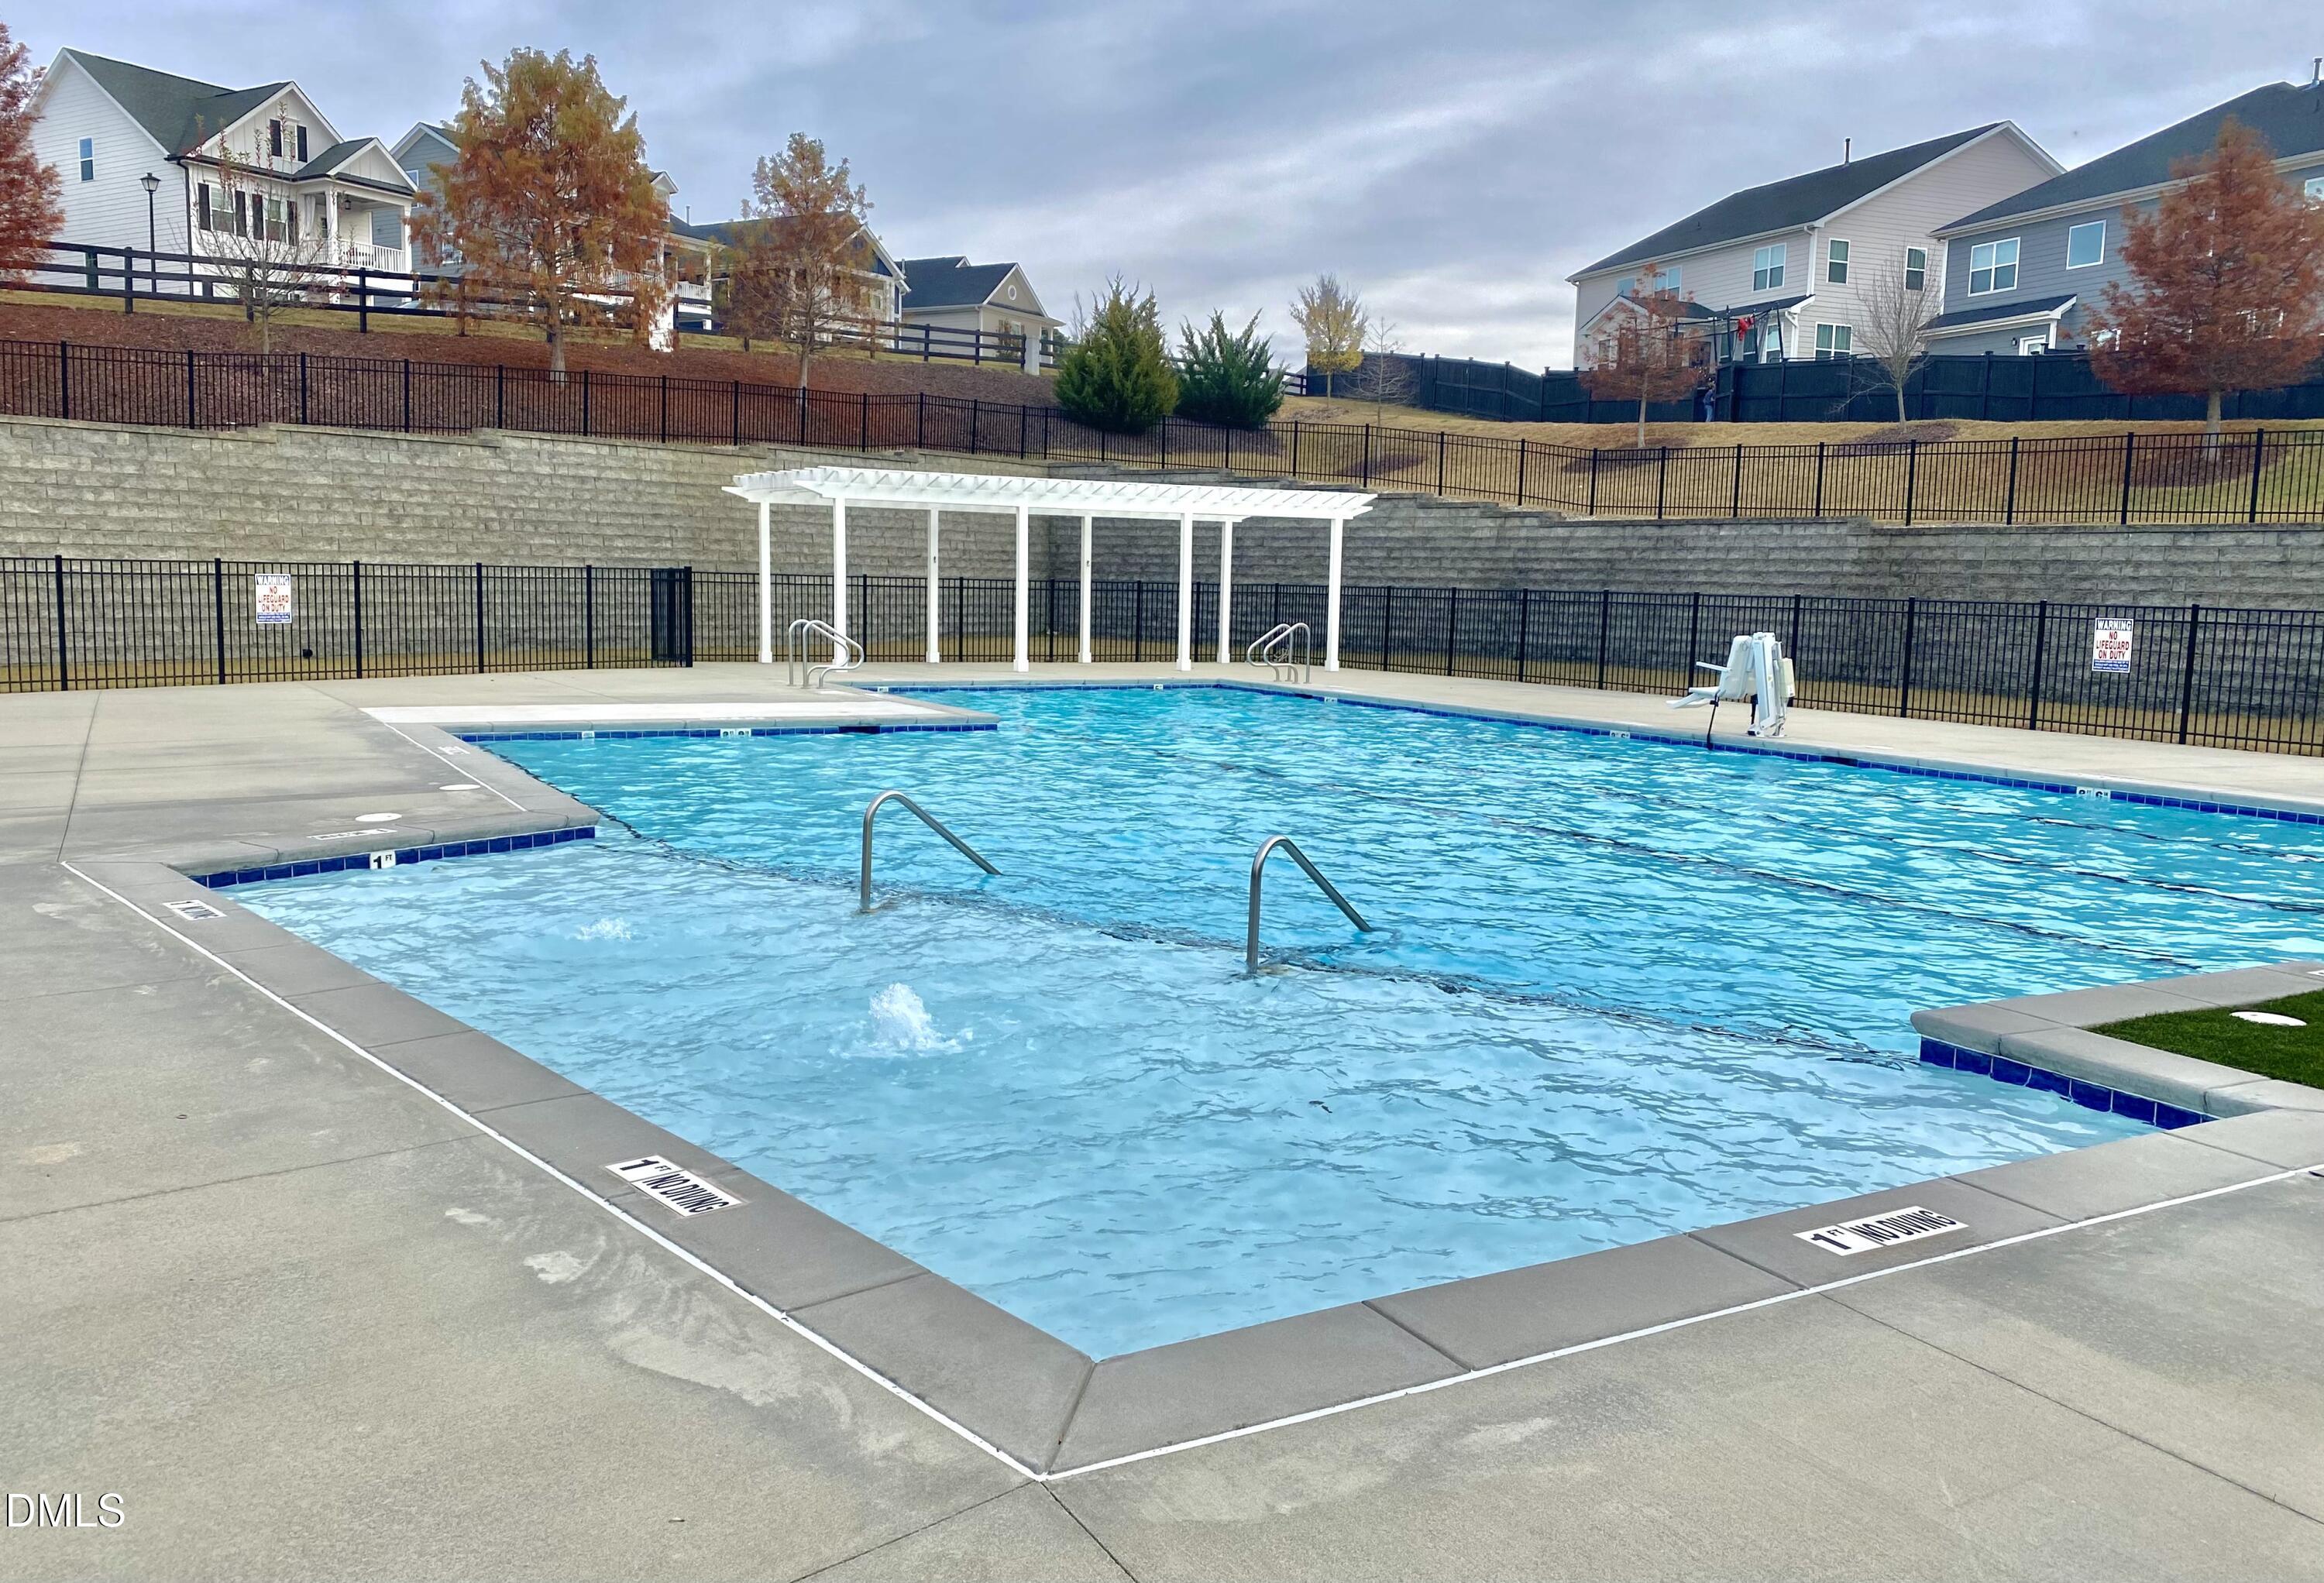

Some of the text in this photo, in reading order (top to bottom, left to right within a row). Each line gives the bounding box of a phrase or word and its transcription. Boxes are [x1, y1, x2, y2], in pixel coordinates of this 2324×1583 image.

[257, 575, 290, 585] WARNING
[270, 585, 277, 594] NO
[2097, 620, 2131, 630] WARNING
[2109, 631, 2117, 640] NO
[2096, 640, 2130, 650] LIFEGUARD
[2099, 650, 2126, 659] ON DUTY
[373, 855, 382, 869] 1
[620, 1159, 660, 1171] 1
[642, 1173, 729, 1213] NO DIVING
[1849, 1210, 1957, 1241] NO DIVING
[1810, 1233, 1851, 1250] 1
